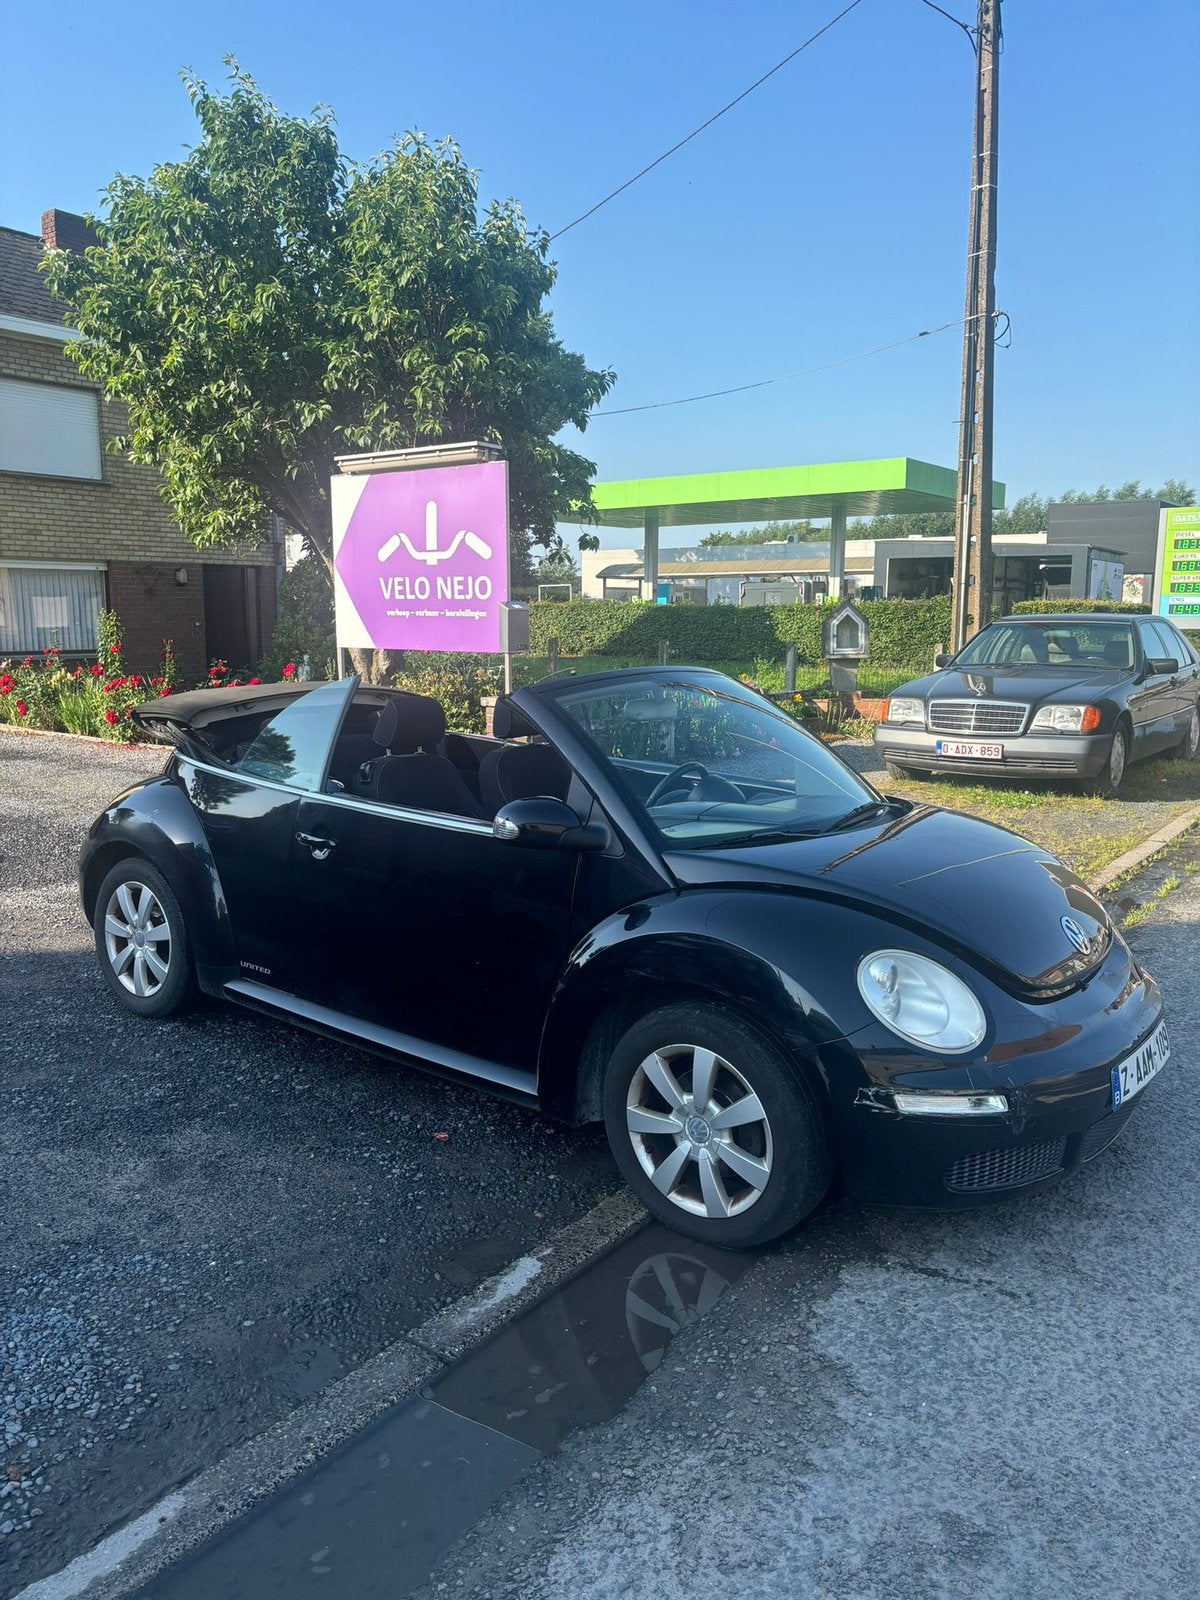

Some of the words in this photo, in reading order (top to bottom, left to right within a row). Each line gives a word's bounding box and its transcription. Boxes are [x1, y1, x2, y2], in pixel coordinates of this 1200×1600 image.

[379, 576, 430, 600] VELO
[437, 575, 492, 600] NEJO
[240, 960, 271, 975] UNITED
[1114, 1090, 1121, 1105] B
